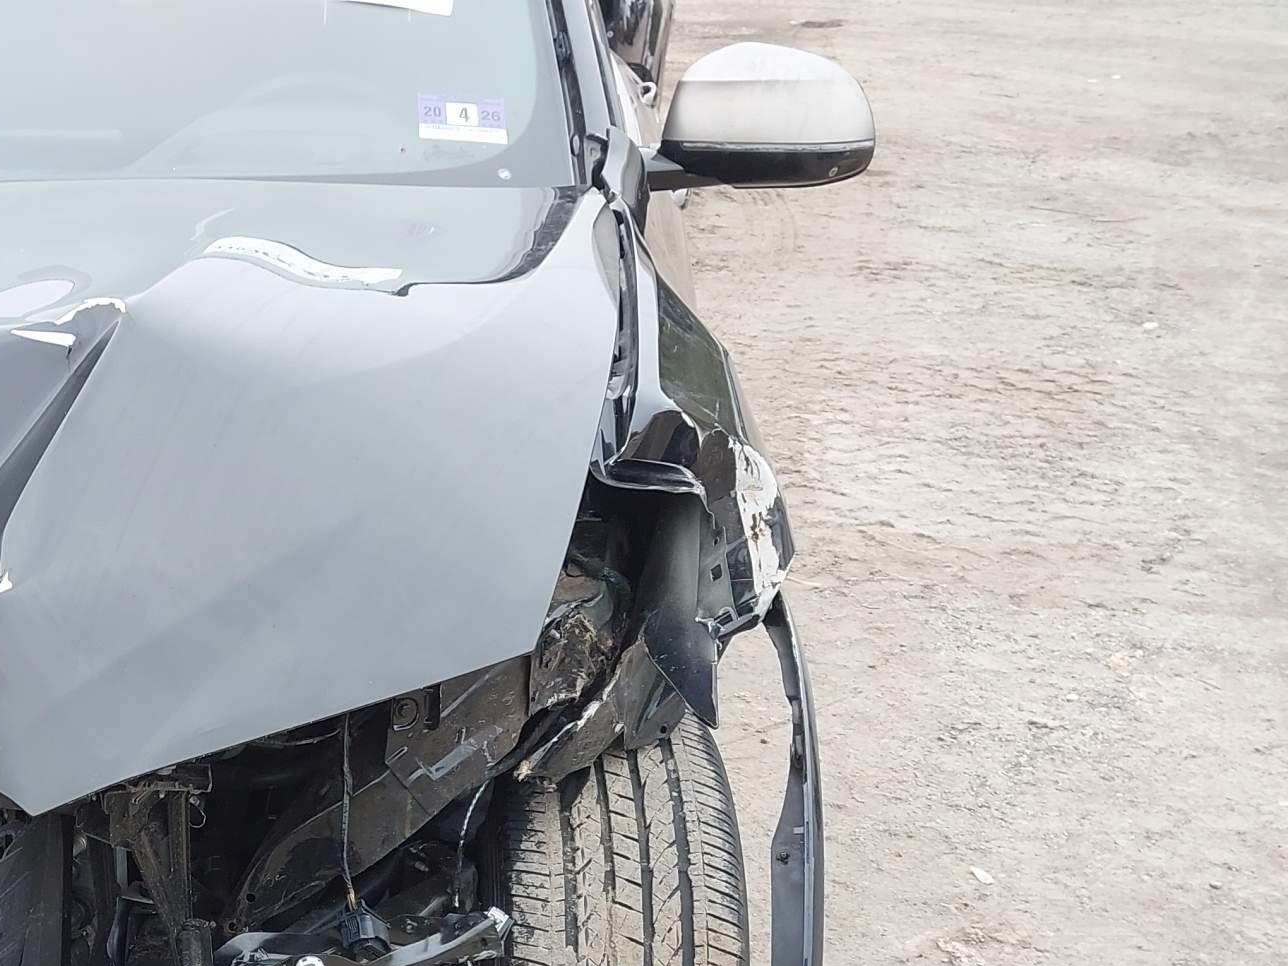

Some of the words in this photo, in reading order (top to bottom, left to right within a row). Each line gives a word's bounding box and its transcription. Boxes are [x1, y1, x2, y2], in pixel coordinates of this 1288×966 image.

[423, 105, 442, 118] 20
[459, 107, 470, 123] 4
[481, 110, 501, 122] 26
